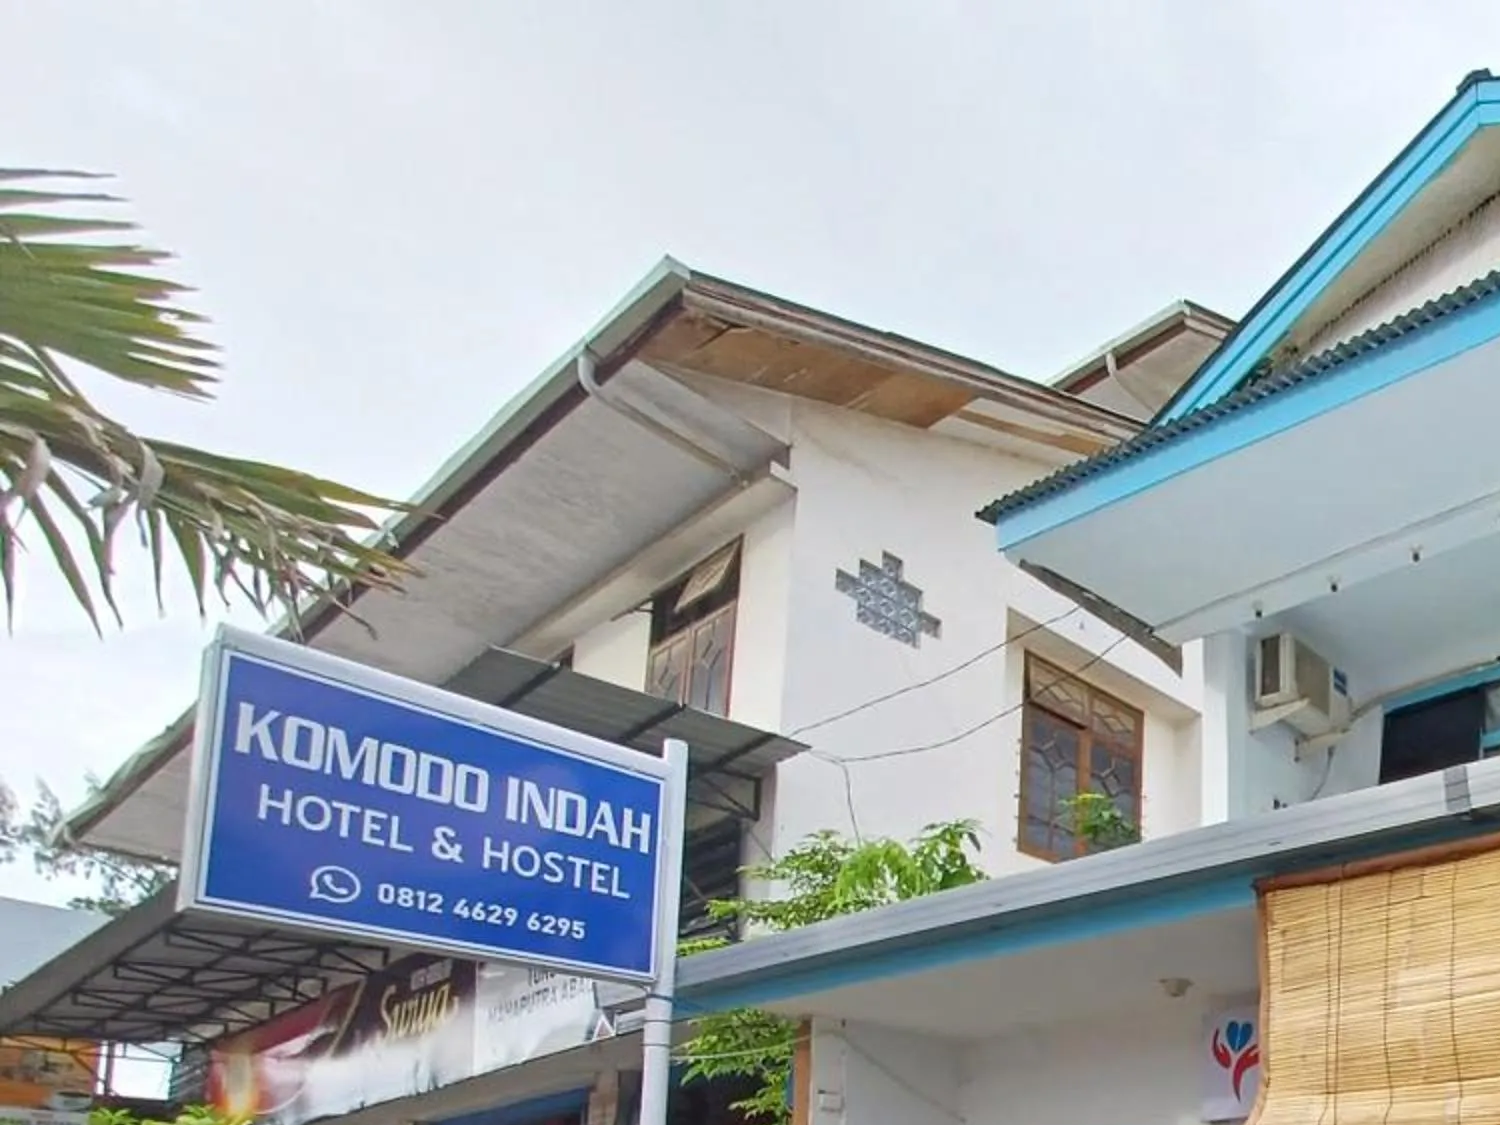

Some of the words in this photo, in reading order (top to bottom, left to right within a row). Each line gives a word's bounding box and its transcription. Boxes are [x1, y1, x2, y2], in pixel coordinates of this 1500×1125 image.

[235, 702, 490, 813] KOMODO
[505, 776, 651, 854] INDAH
[258, 783, 414, 852] HOTEL
[431, 825, 464, 863] &
[482, 836, 630, 899] HOSTEL
[377, 883, 443, 914] 0812
[453, 898, 518, 927] 4629
[526, 912, 586, 940] 6295
